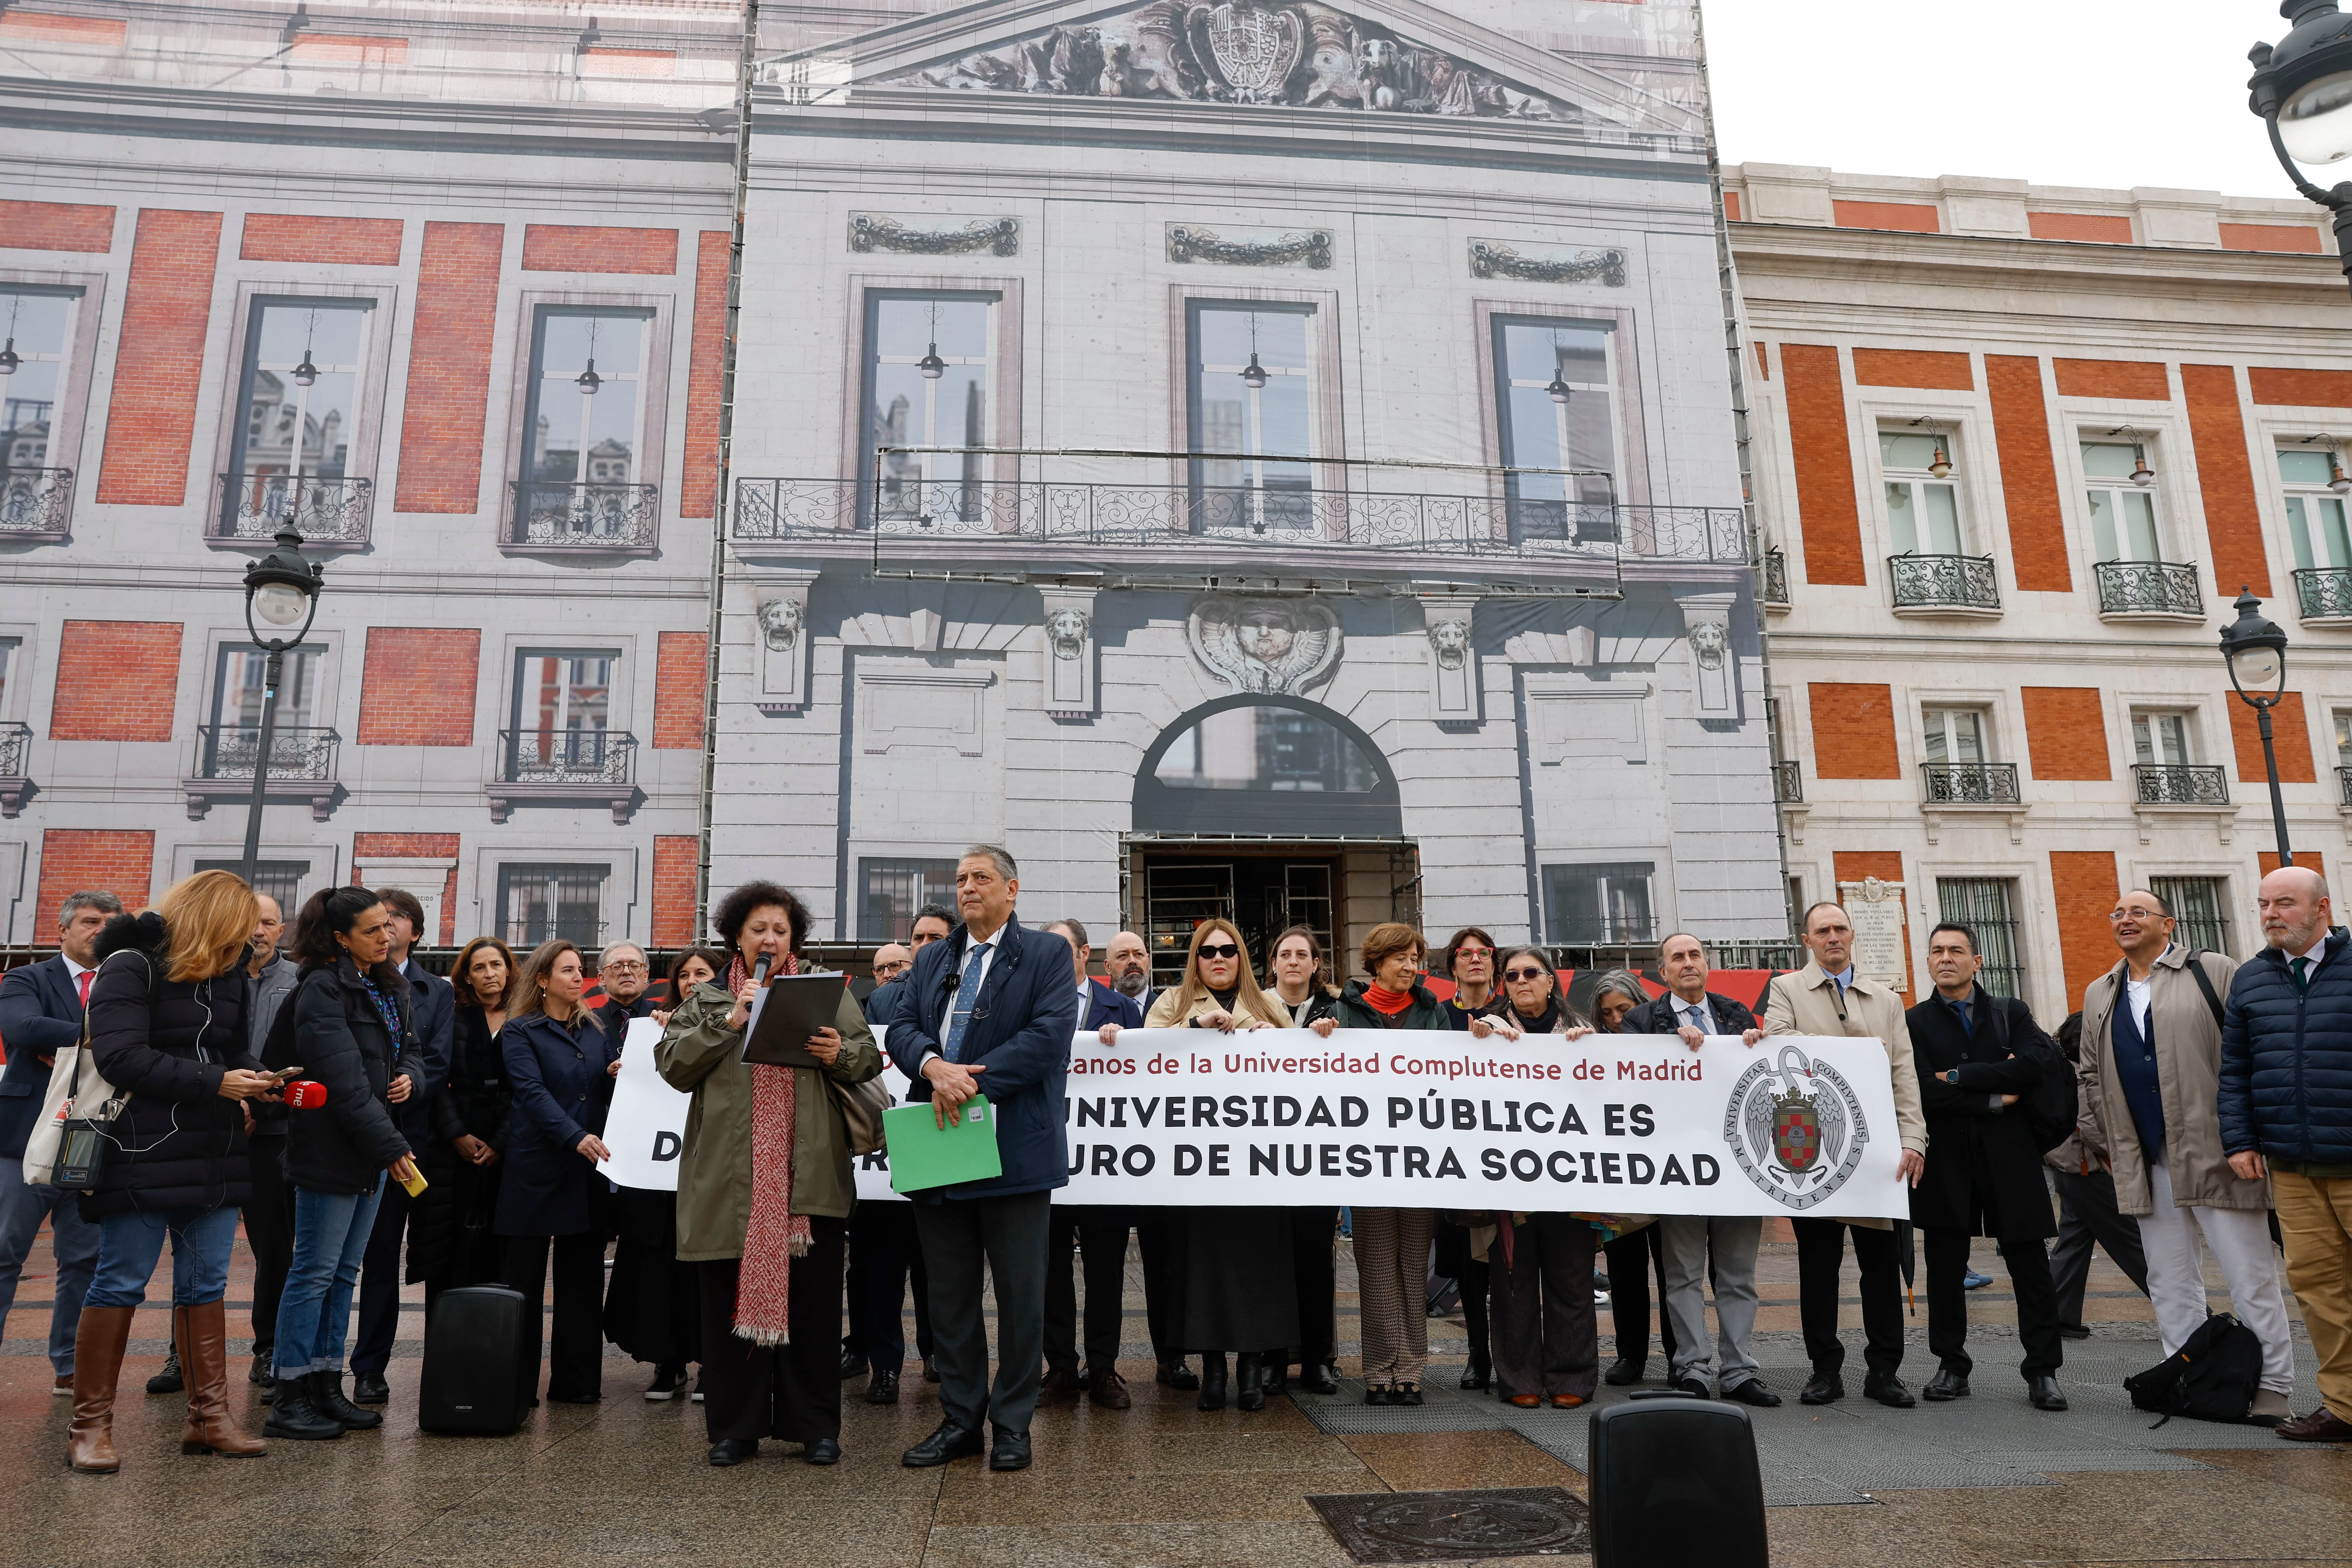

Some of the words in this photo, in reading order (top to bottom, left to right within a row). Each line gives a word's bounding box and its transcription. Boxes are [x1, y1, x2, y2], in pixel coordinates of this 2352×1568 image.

[1148, 1053, 1179, 1075] de
[1191, 1052, 1212, 1074] la
[1225, 1051, 1380, 1074] Universidad
[1391, 1054, 1561, 1081] Complutense
[1573, 1059, 1605, 1081] de
[1617, 1059, 1702, 1081] Madrid
[293, 1088, 304, 1107] rne
[1387, 1088, 1589, 1135] PÚBLICA
[1603, 1104, 1655, 1137] ES
[1726, 1063, 1766, 1137] VNIVERSITAS
[1817, 1063, 1867, 1138] COMPLVTENSIS
[1173, 1144, 1230, 1177] DE
[1249, 1143, 1467, 1179] NUESTRA
[1480, 1148, 1721, 1186] SOCIEDAD
[1733, 1147, 1861, 1208] MATRITENSIS
